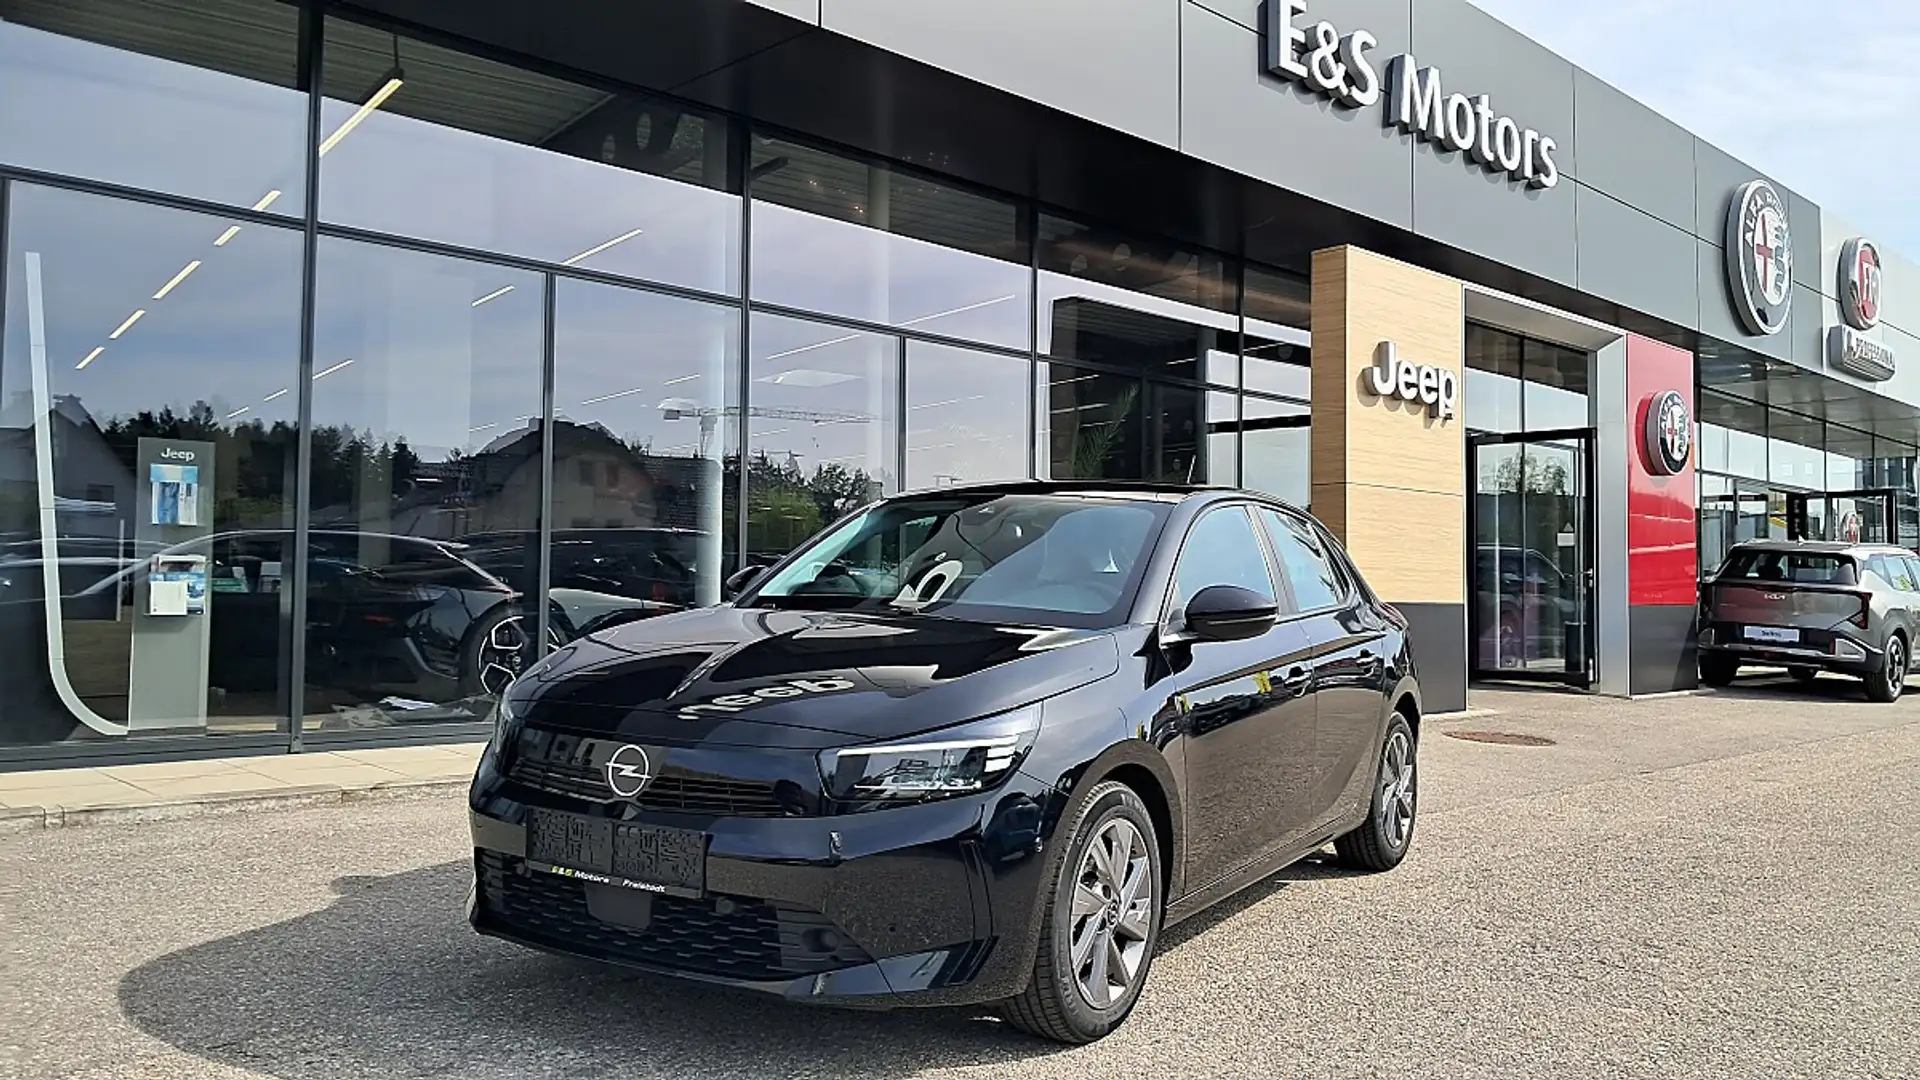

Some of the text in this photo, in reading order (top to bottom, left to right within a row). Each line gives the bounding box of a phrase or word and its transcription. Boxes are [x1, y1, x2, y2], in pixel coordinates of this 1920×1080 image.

[1272, 0, 1558, 188] E&S Motors
[1372, 340, 1457, 418] Jeep
[160, 447, 195, 462] Jeep
